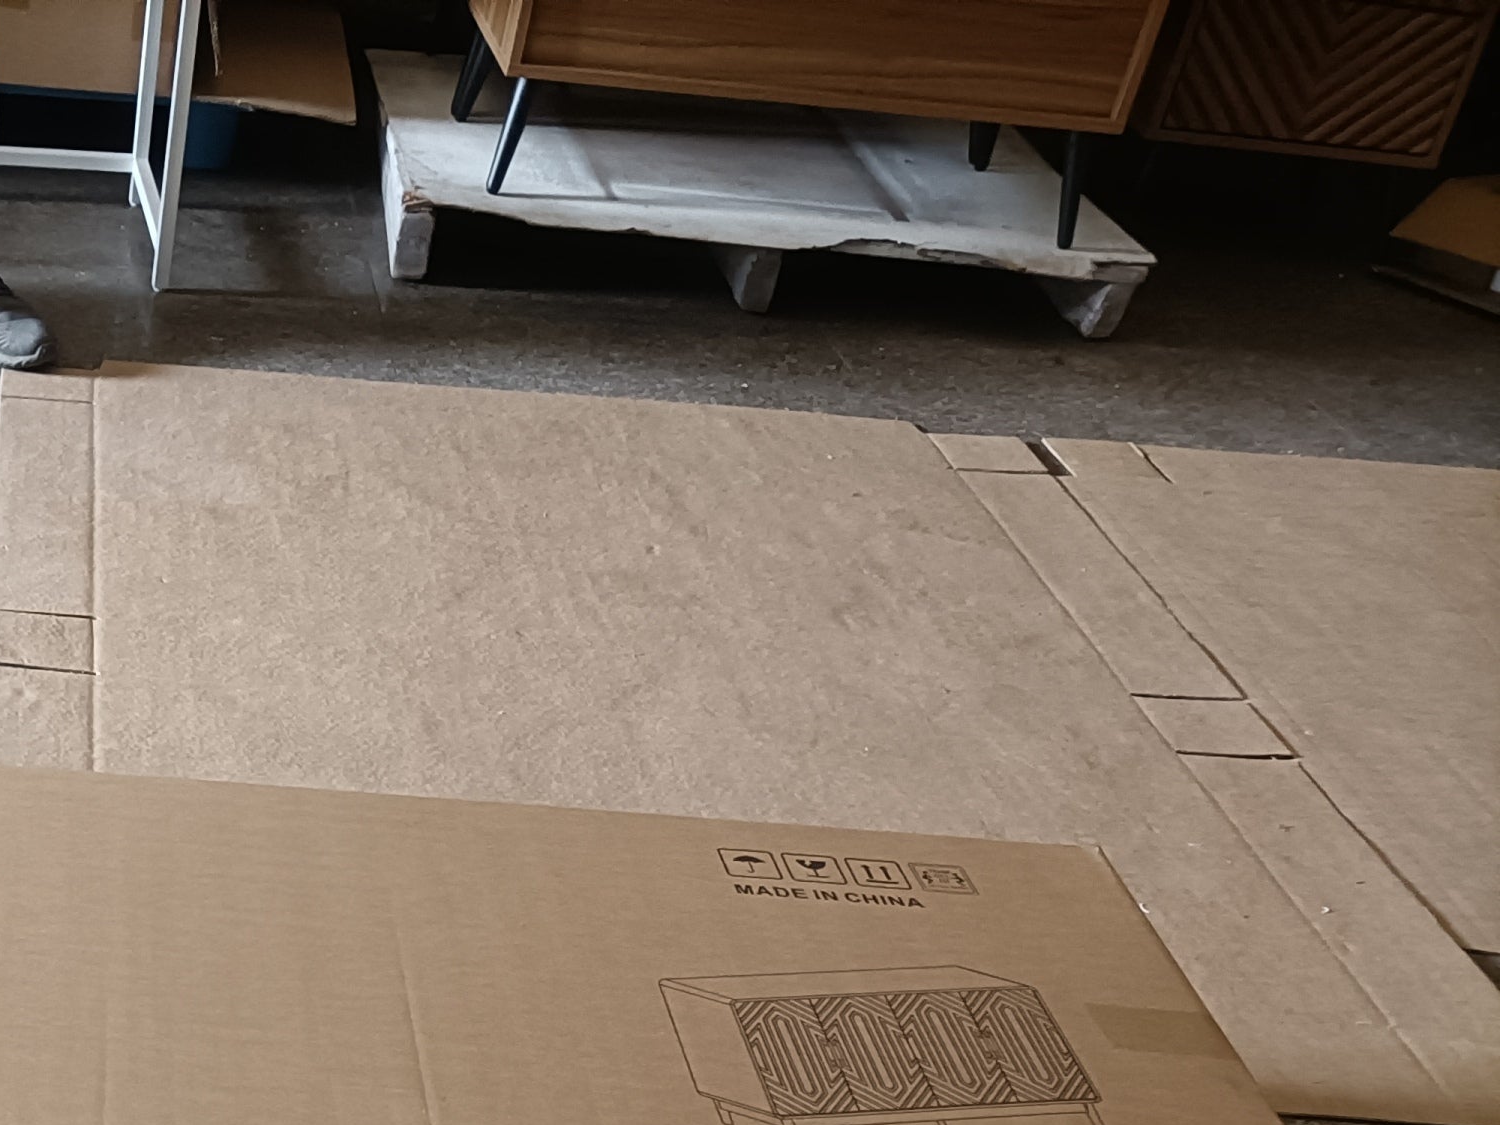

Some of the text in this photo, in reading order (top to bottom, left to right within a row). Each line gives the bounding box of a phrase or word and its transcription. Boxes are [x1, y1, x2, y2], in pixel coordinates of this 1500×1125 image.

[734, 883, 926, 908] MADE IN CHINA
